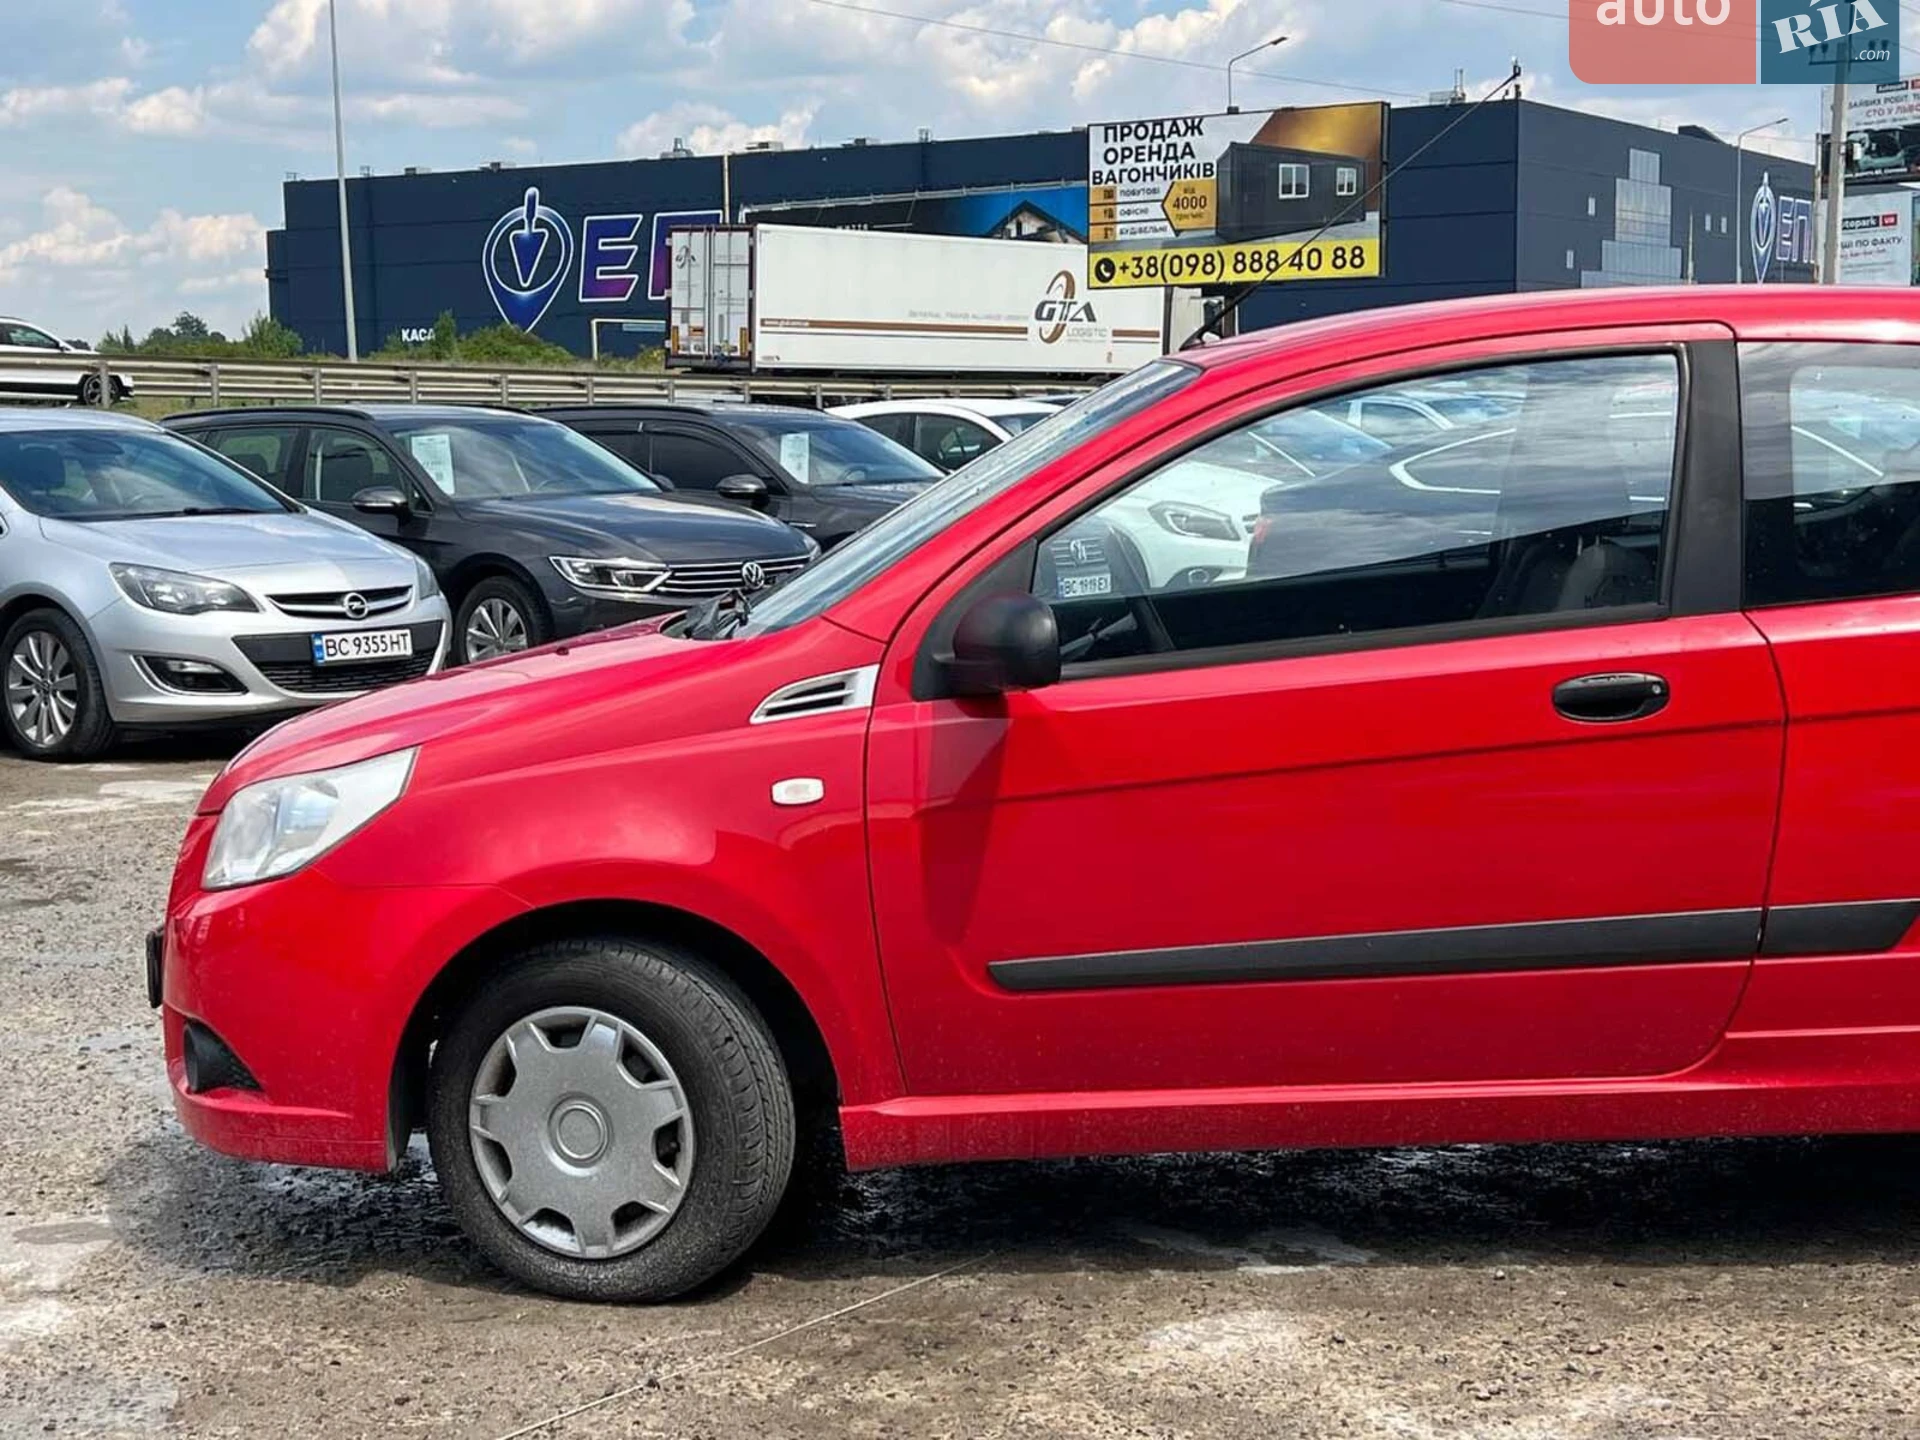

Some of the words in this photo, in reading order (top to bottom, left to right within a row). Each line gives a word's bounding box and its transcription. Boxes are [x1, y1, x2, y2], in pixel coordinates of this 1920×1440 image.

[1104, 117, 1204, 143] ПРОДАЖ
[1103, 141, 1196, 165] ОРЕНДА
[1092, 162, 1215, 186] ВАГОНЧИКІВ
[1119, 187, 1160, 197] ПОБУТОВІ
[1173, 195, 1207, 210] 4000
[1119, 207, 1149, 216] ОФІСНІ
[1871, 236, 1902, 247] ФАКТУ
[1120, 250, 1225, 283] +38(098)
[1233, 250, 1279, 274] 888
[1288, 247, 1322, 272] 40
[1332, 246, 1365, 270] 88
[1035, 300, 1097, 322] GTA
[325, 638, 350, 656] BC
[353, 635, 388, 655] 9355
[390, 633, 408, 652] HT
